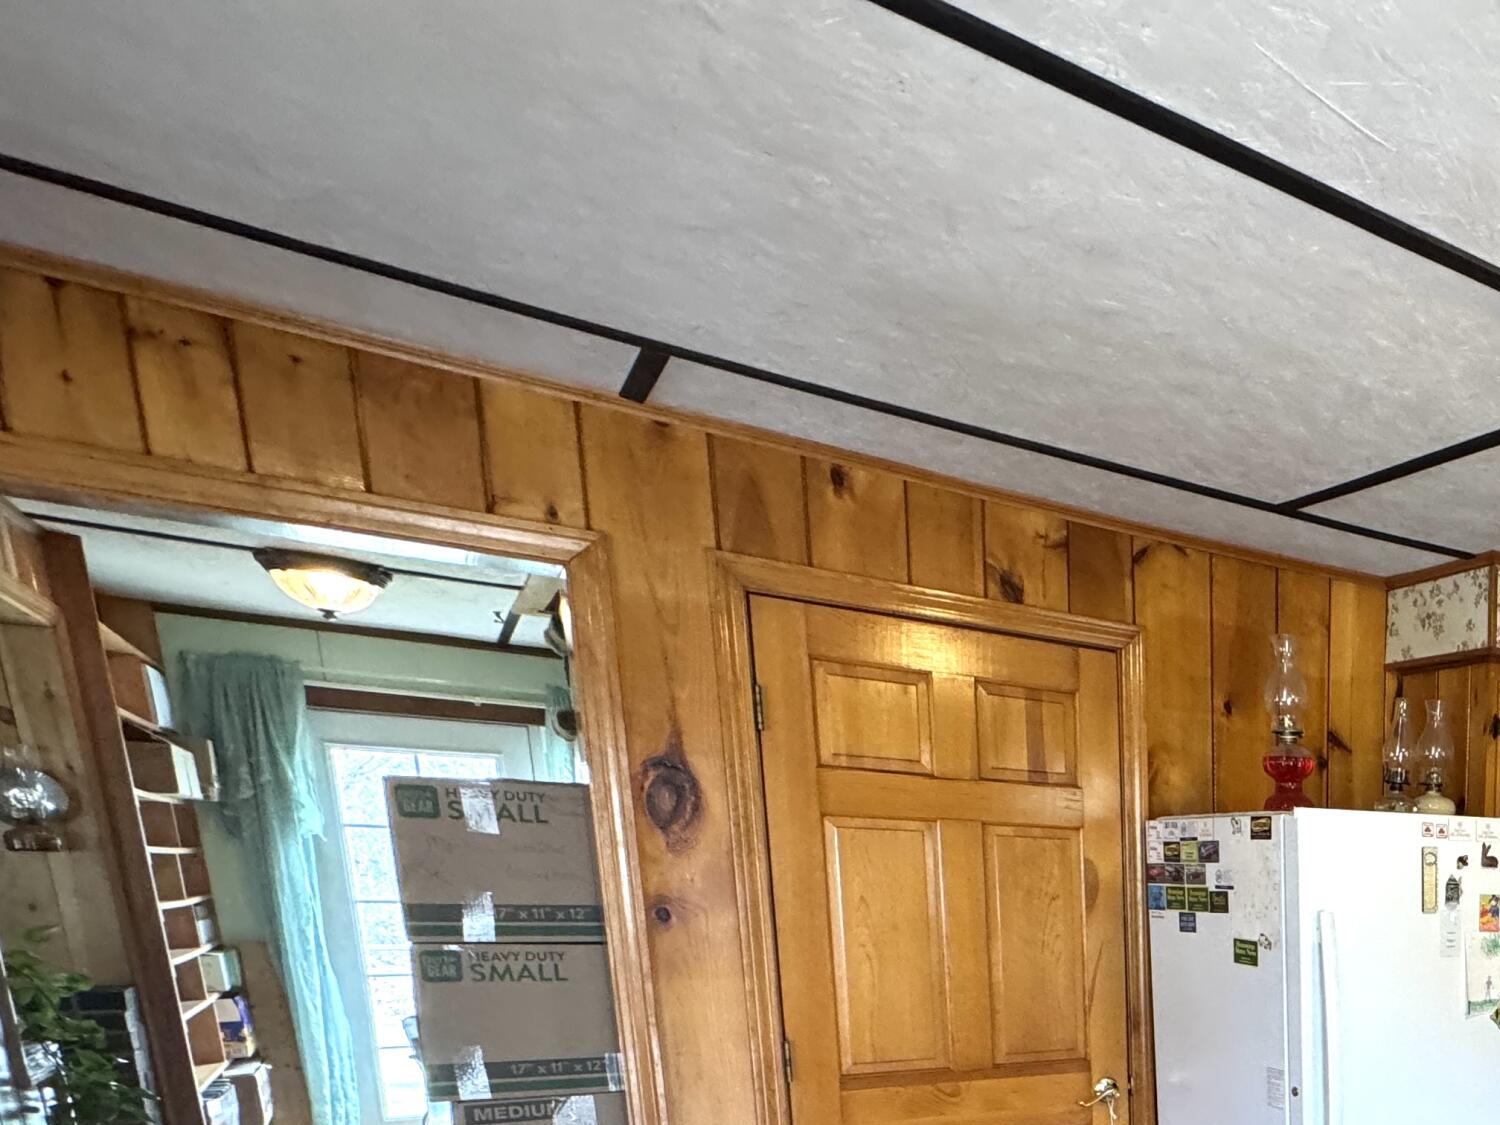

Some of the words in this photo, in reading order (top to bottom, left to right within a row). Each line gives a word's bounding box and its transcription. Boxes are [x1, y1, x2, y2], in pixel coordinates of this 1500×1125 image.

[503, 790, 545, 803] DUTY
[447, 800, 549, 824] SALL
[468, 951, 520, 962] HEAVY
[525, 951, 566, 962] DUTY
[469, 962, 569, 983] SMALL
